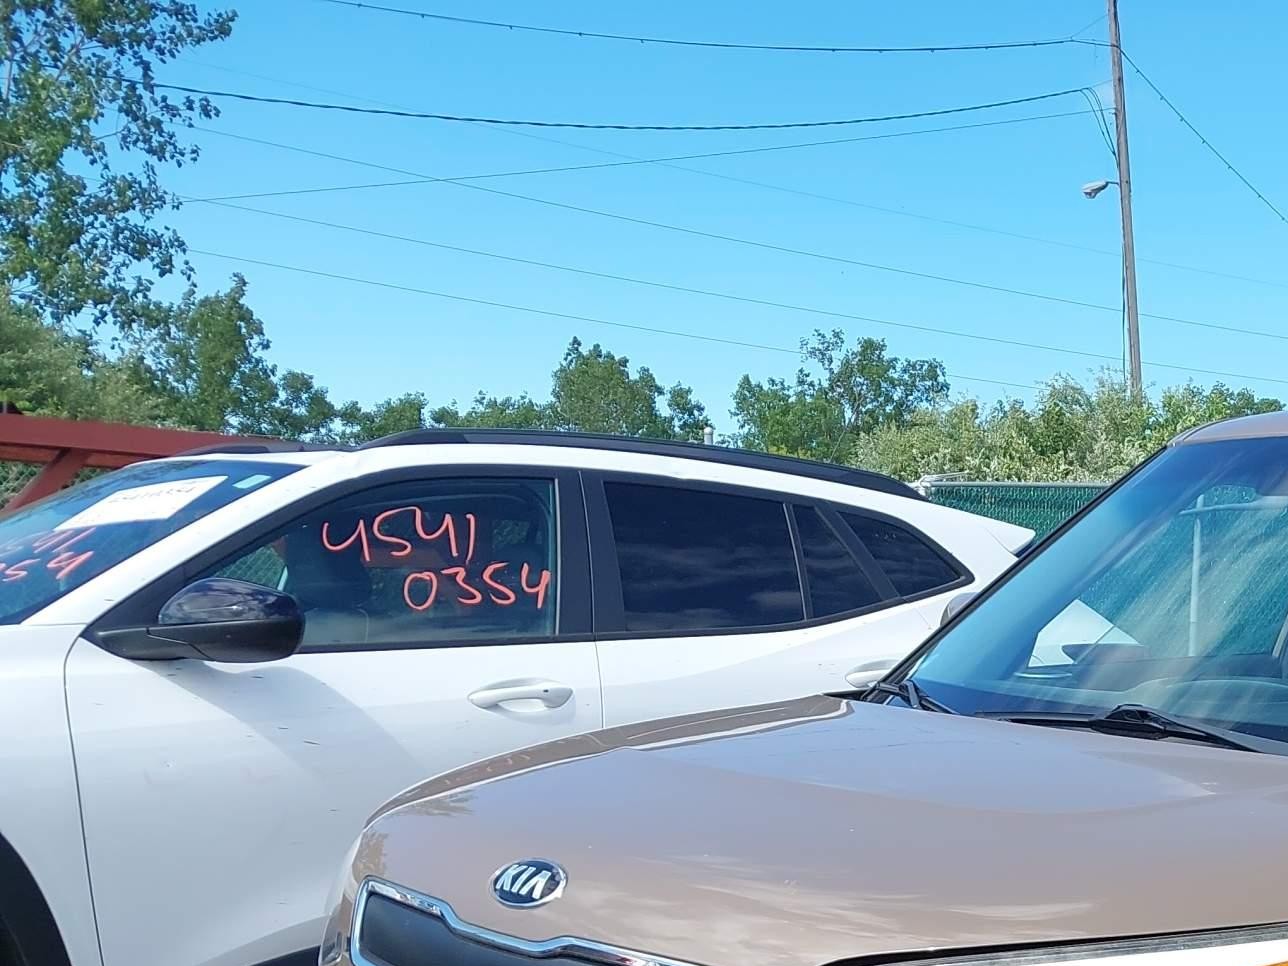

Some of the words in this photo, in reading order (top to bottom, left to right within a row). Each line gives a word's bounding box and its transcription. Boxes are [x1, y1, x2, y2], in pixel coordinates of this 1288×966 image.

[321, 506, 476, 564] 4541
[403, 562, 551, 611] 0354
[495, 864, 552, 900] KIA
